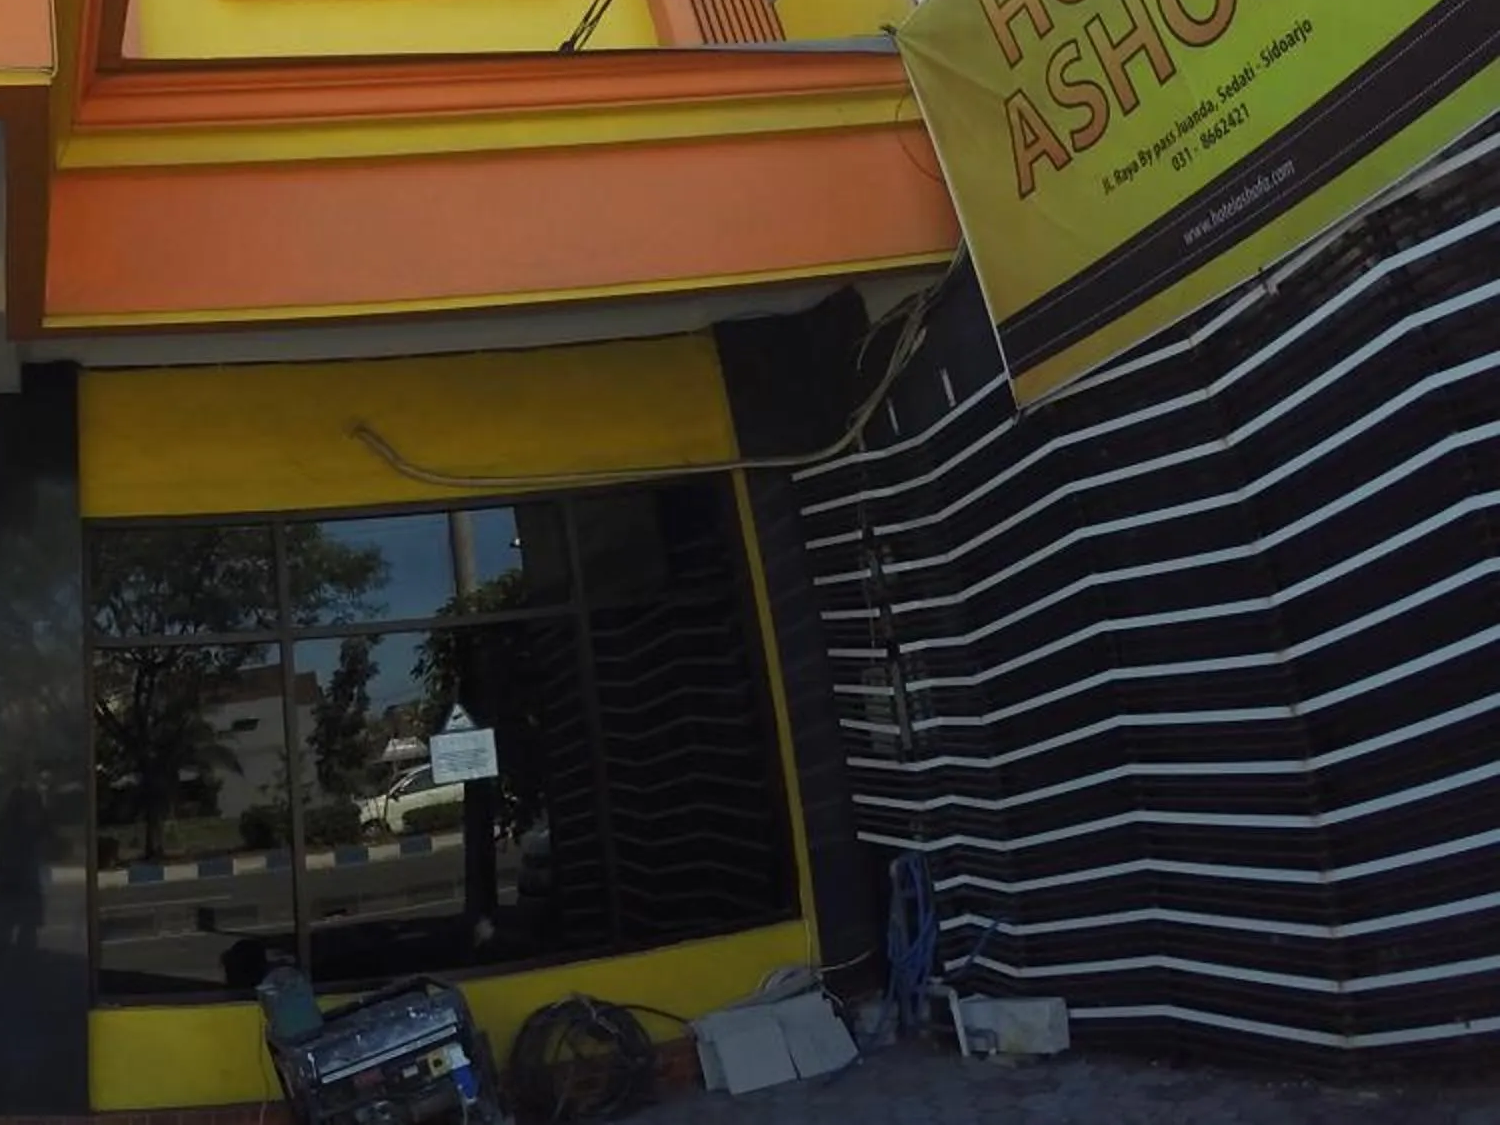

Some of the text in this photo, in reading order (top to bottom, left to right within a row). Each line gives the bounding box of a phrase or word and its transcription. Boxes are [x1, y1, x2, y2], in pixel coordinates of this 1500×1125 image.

[1112, 161, 1139, 187] Raya
[1136, 149, 1154, 168] By
[1152, 132, 1178, 162] pass
[1175, 97, 1220, 140] Juanda,
[1216, 61, 1257, 104] Sedati
[1259, 17, 1313, 68] Sidoarjo
[1170, 146, 1194, 172] 031
[1199, 102, 1251, 150] 8662421
